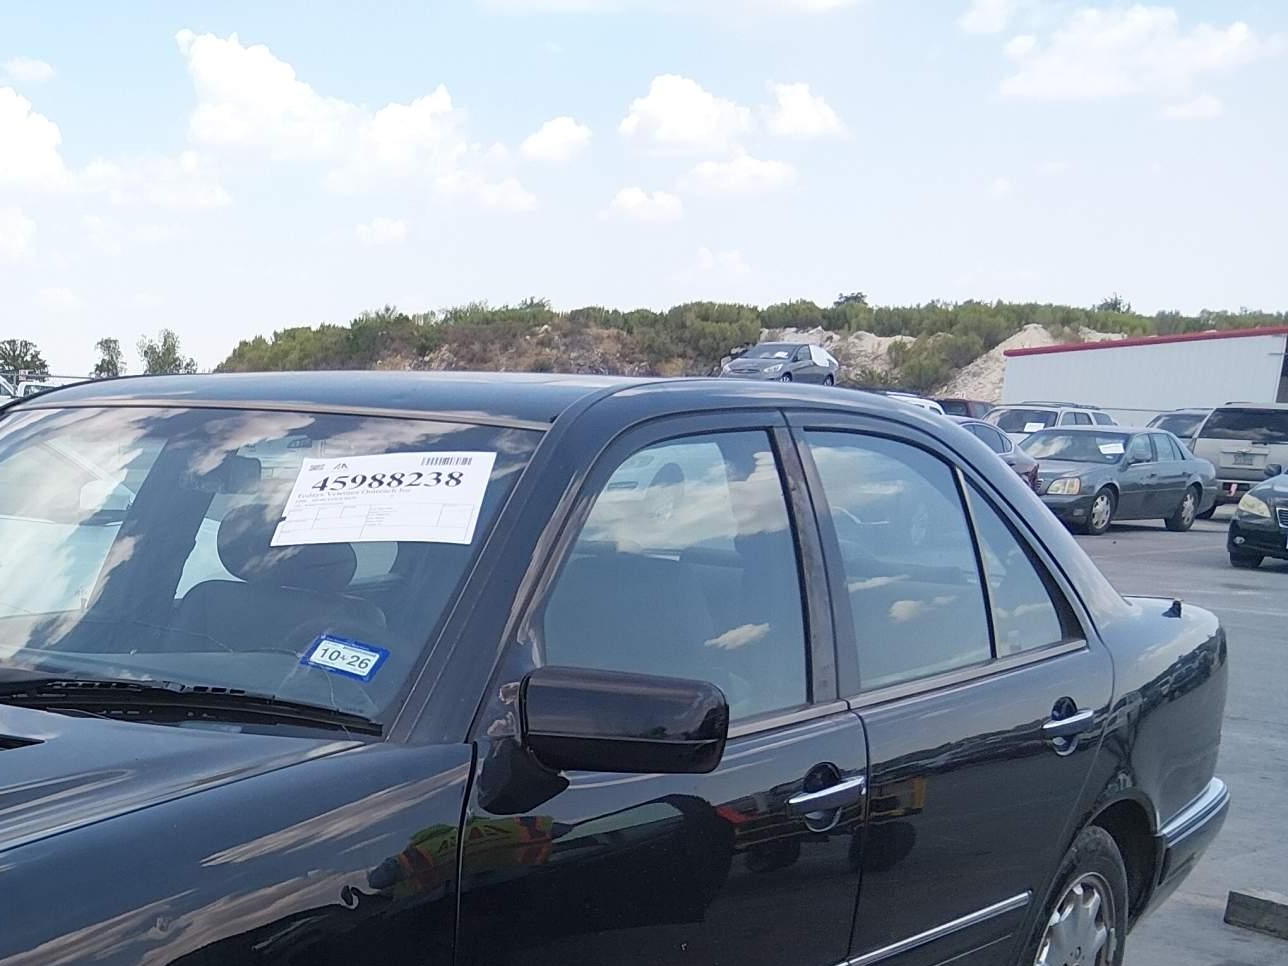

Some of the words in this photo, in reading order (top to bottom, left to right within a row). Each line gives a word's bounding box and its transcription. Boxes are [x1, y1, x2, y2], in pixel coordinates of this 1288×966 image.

[312, 472, 464, 491] 45988238
[320, 647, 341, 661] 10
[346, 655, 371, 669] 26
